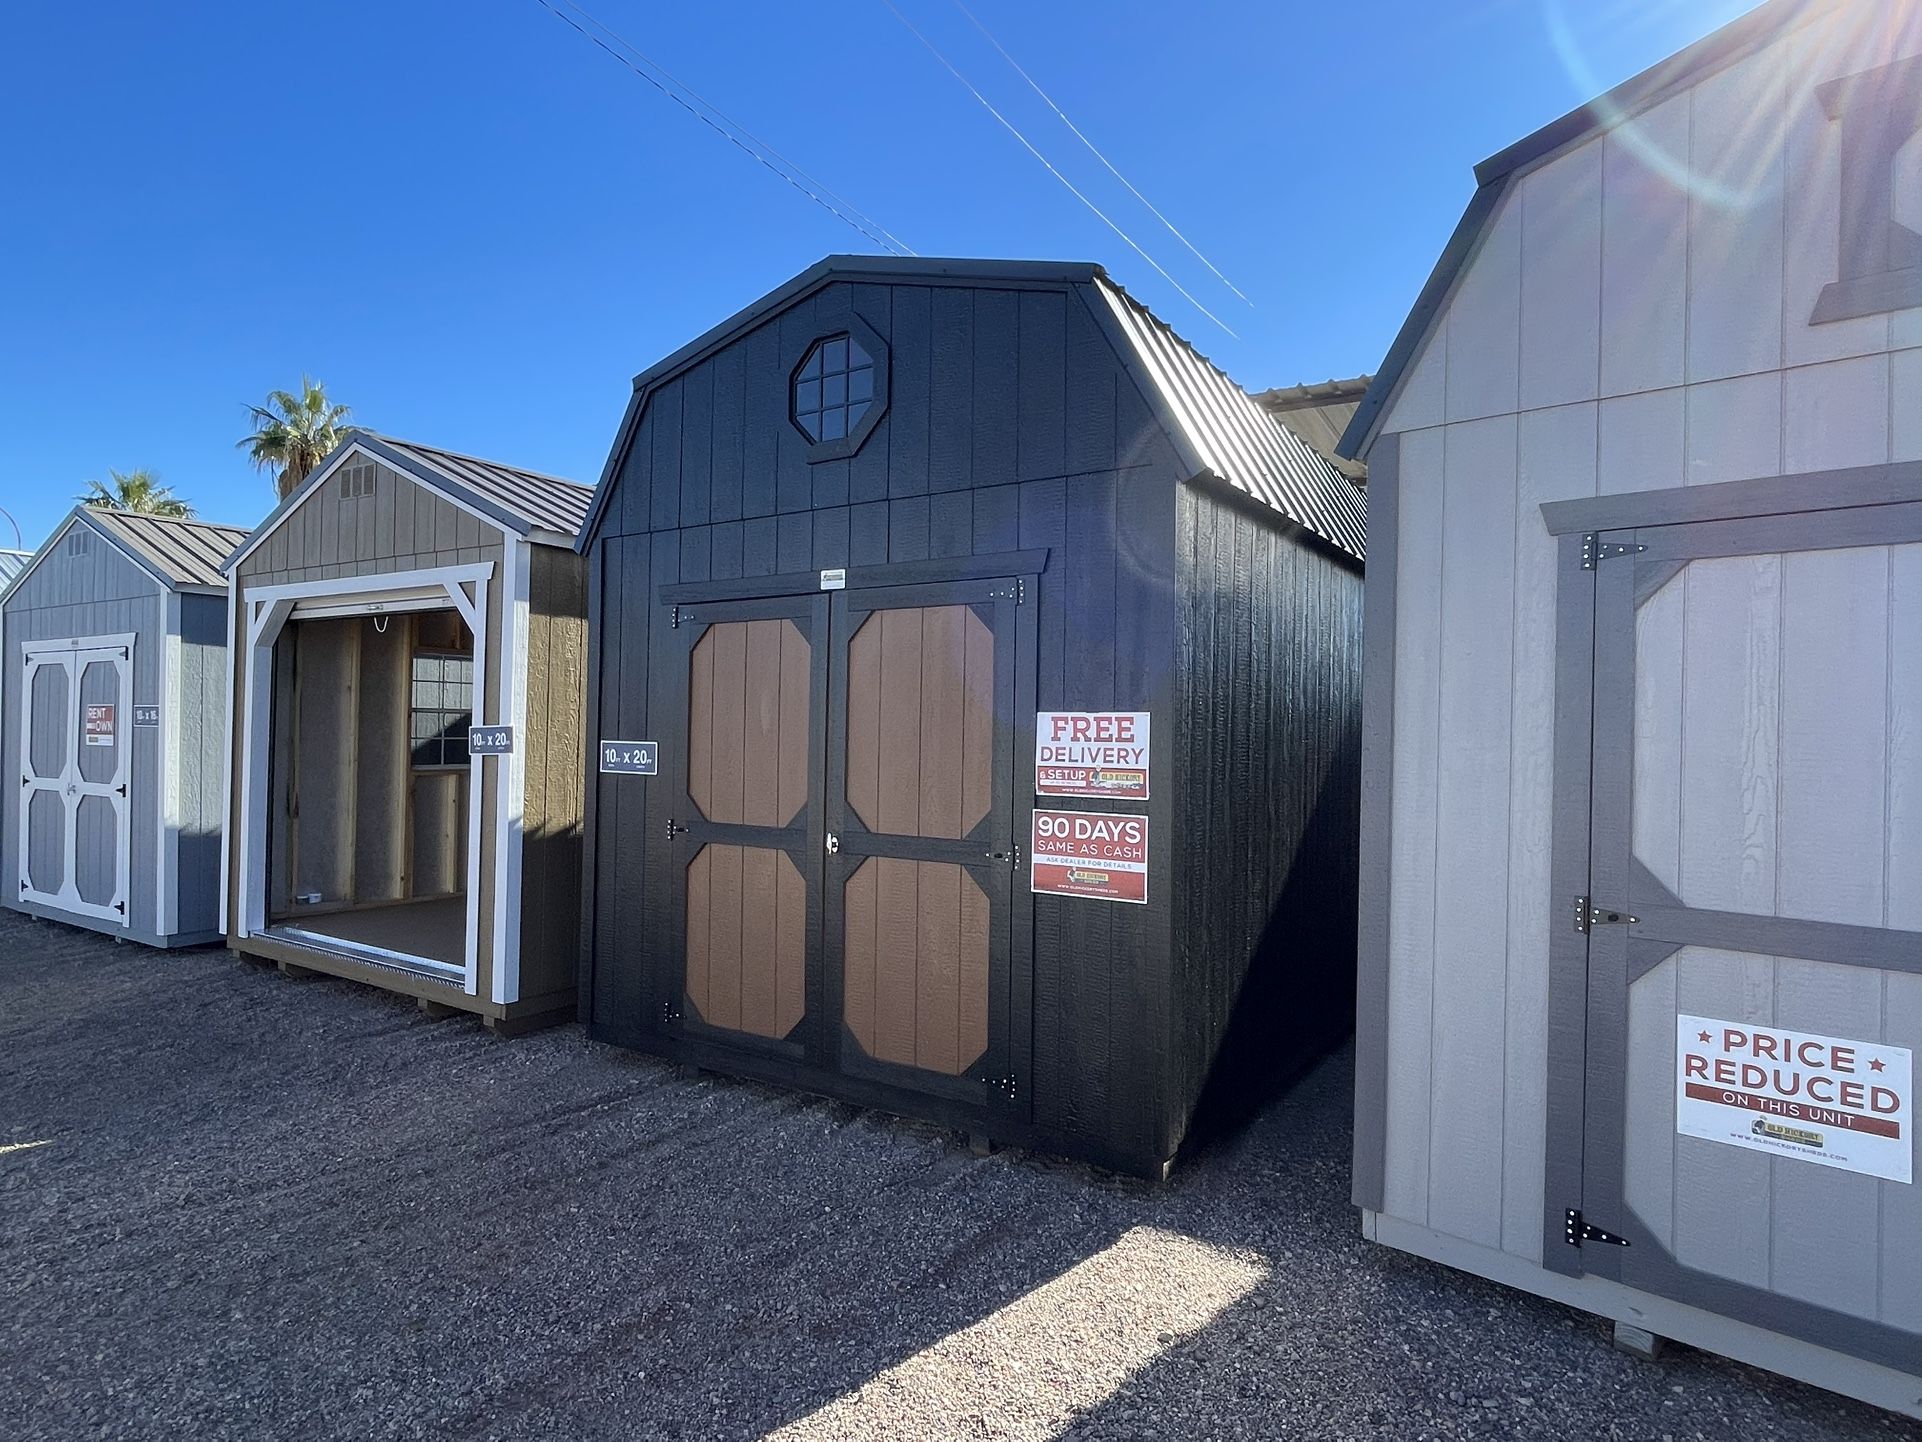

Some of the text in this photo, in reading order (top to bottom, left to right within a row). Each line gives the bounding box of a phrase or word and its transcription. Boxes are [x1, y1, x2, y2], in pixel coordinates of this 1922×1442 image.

[88, 708, 106, 719] RENT
[96, 721, 113, 732] OWN
[1051, 716, 1135, 743] FREE
[1040, 746, 1145, 765] DELIVERY
[1047, 769, 1086, 780] SETUP
[1038, 815, 1141, 844] 90 DAYS
[1038, 840, 1142, 859] SAME AS CASH
[1060, 858, 1087, 866] DEALER
[1723, 1028, 1855, 1074] PRICE
[1685, 1053, 1900, 1114] REDUCED
[1722, 1091, 1855, 1127] ON THIS UNIT
